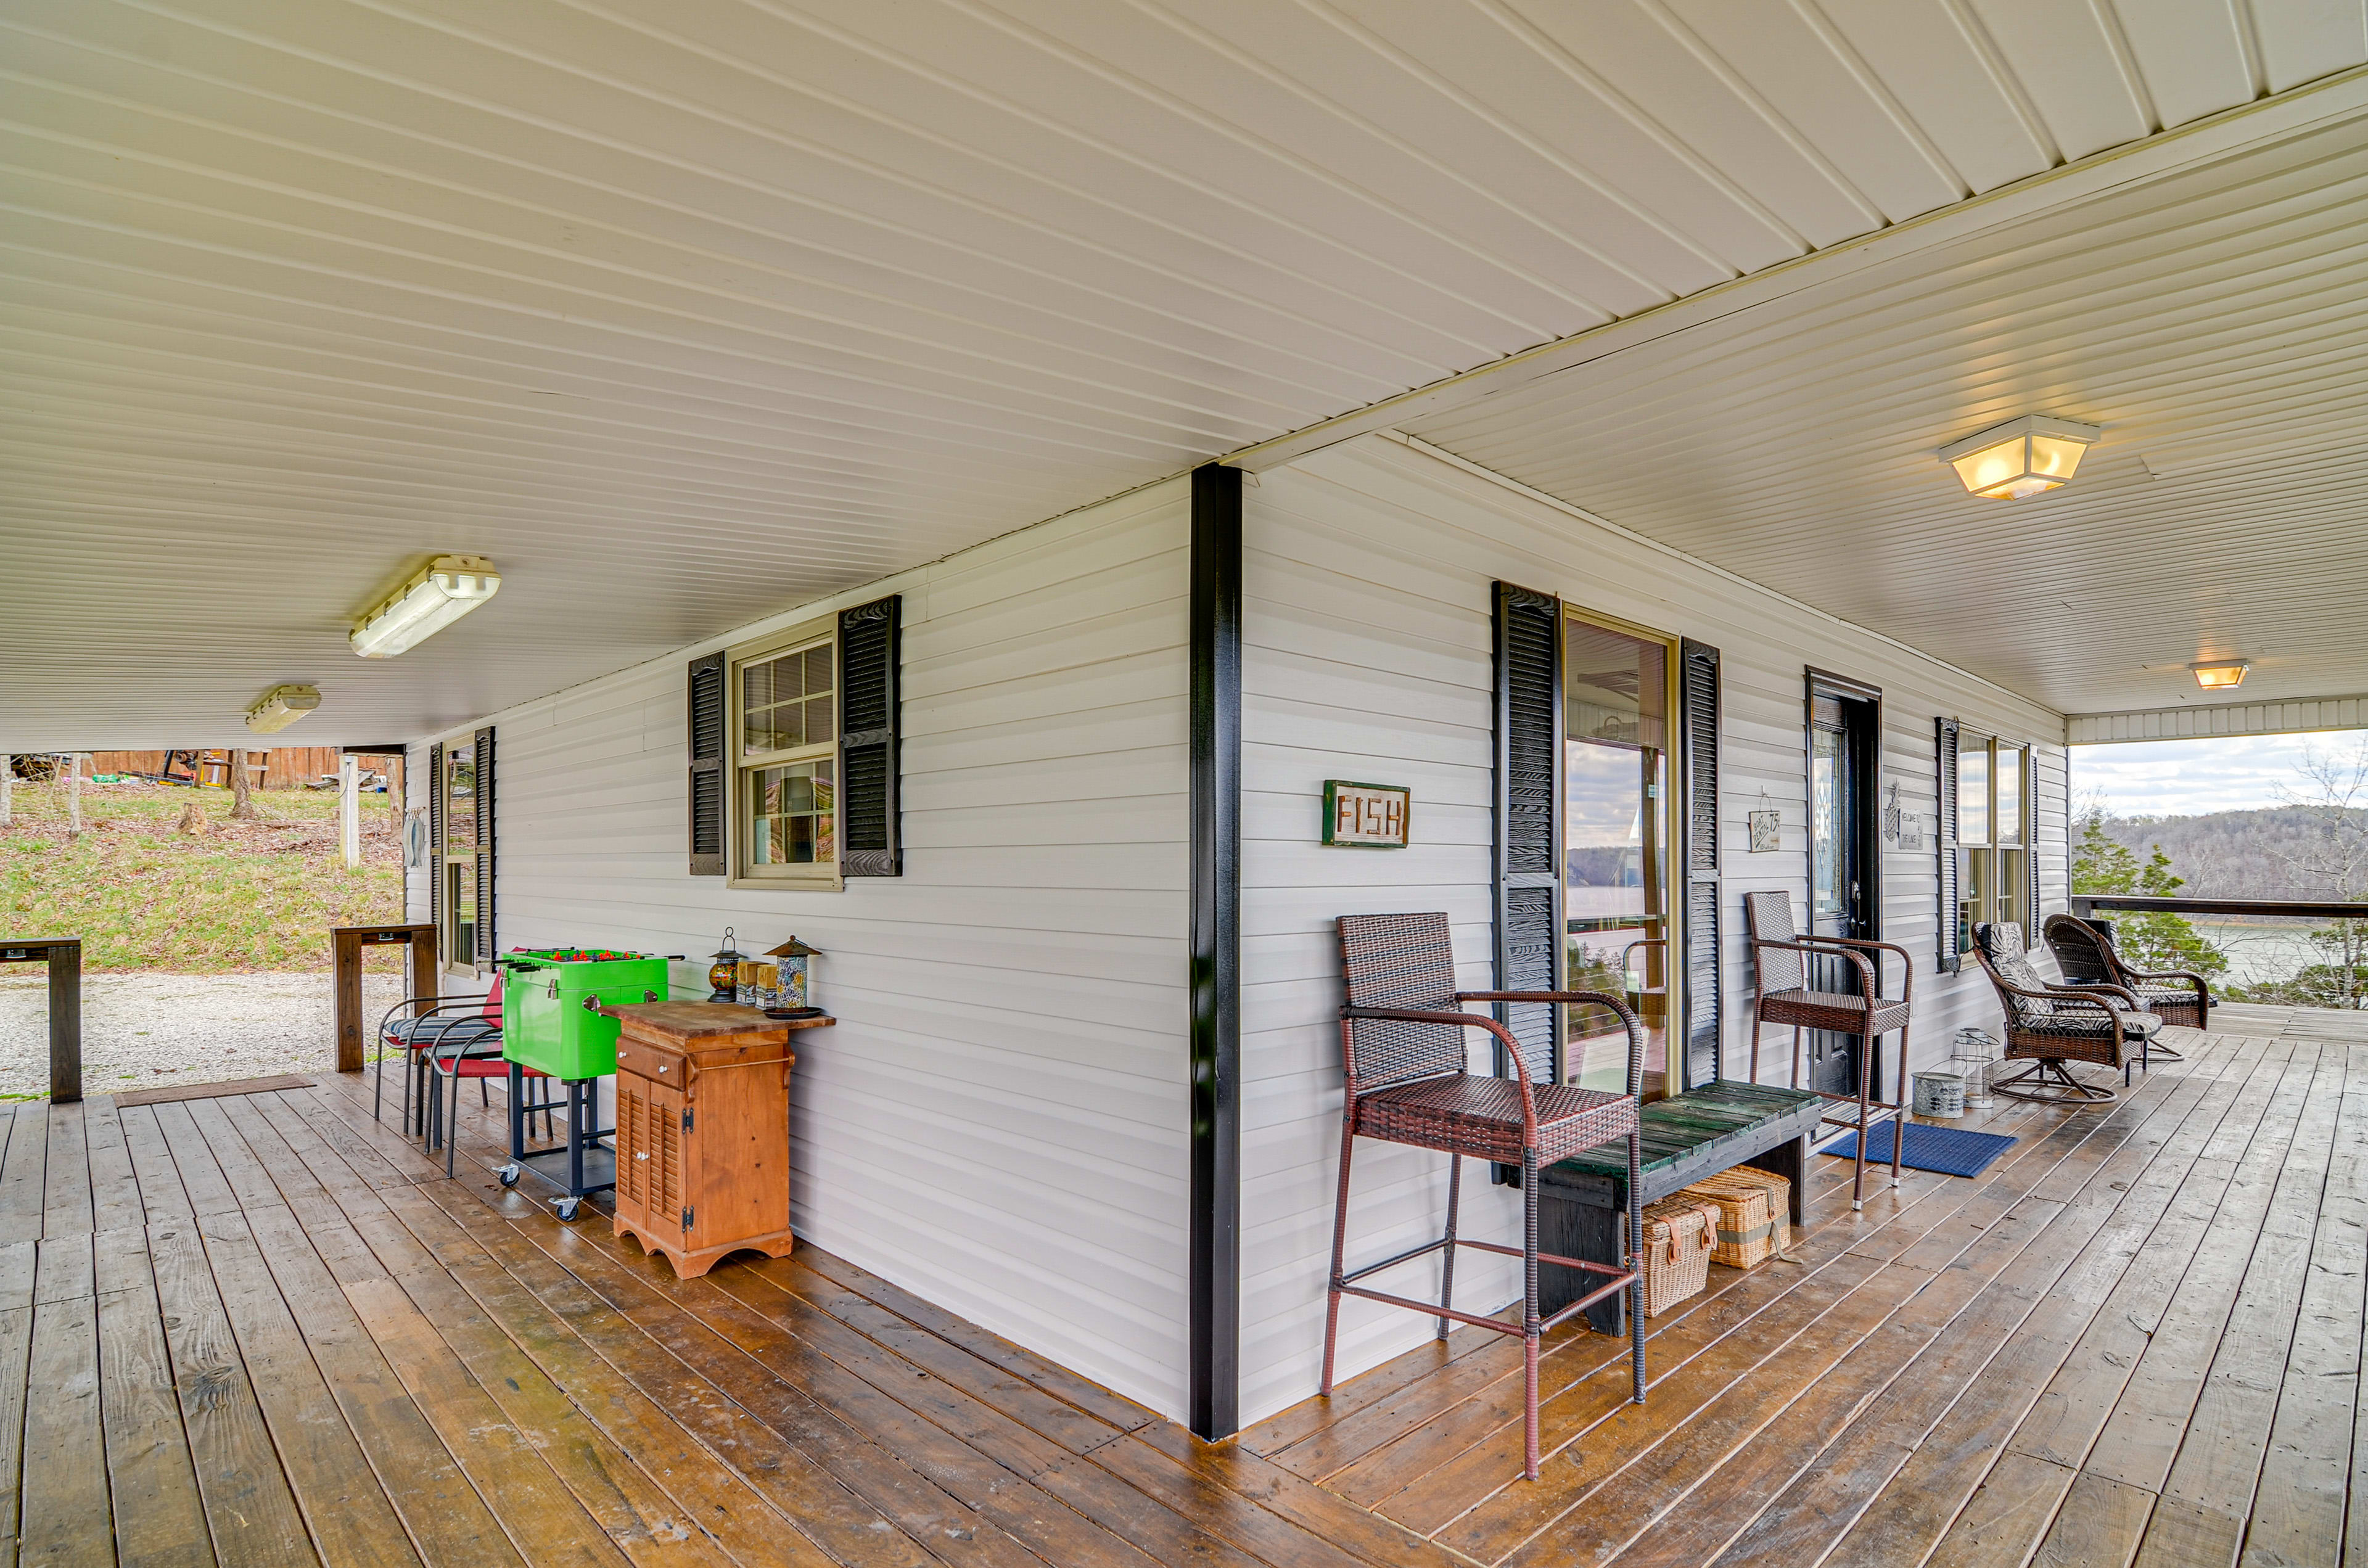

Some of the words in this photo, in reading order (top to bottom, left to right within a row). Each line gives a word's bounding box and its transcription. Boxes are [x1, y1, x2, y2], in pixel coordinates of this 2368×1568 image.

[1337, 795, 1402, 835] FISH
[1753, 815, 1764, 832] BOAT
[1901, 813, 1915, 823] WELCOME
[1753, 821, 1769, 845] RENTAL
[1909, 834, 1917, 844] LAKE
